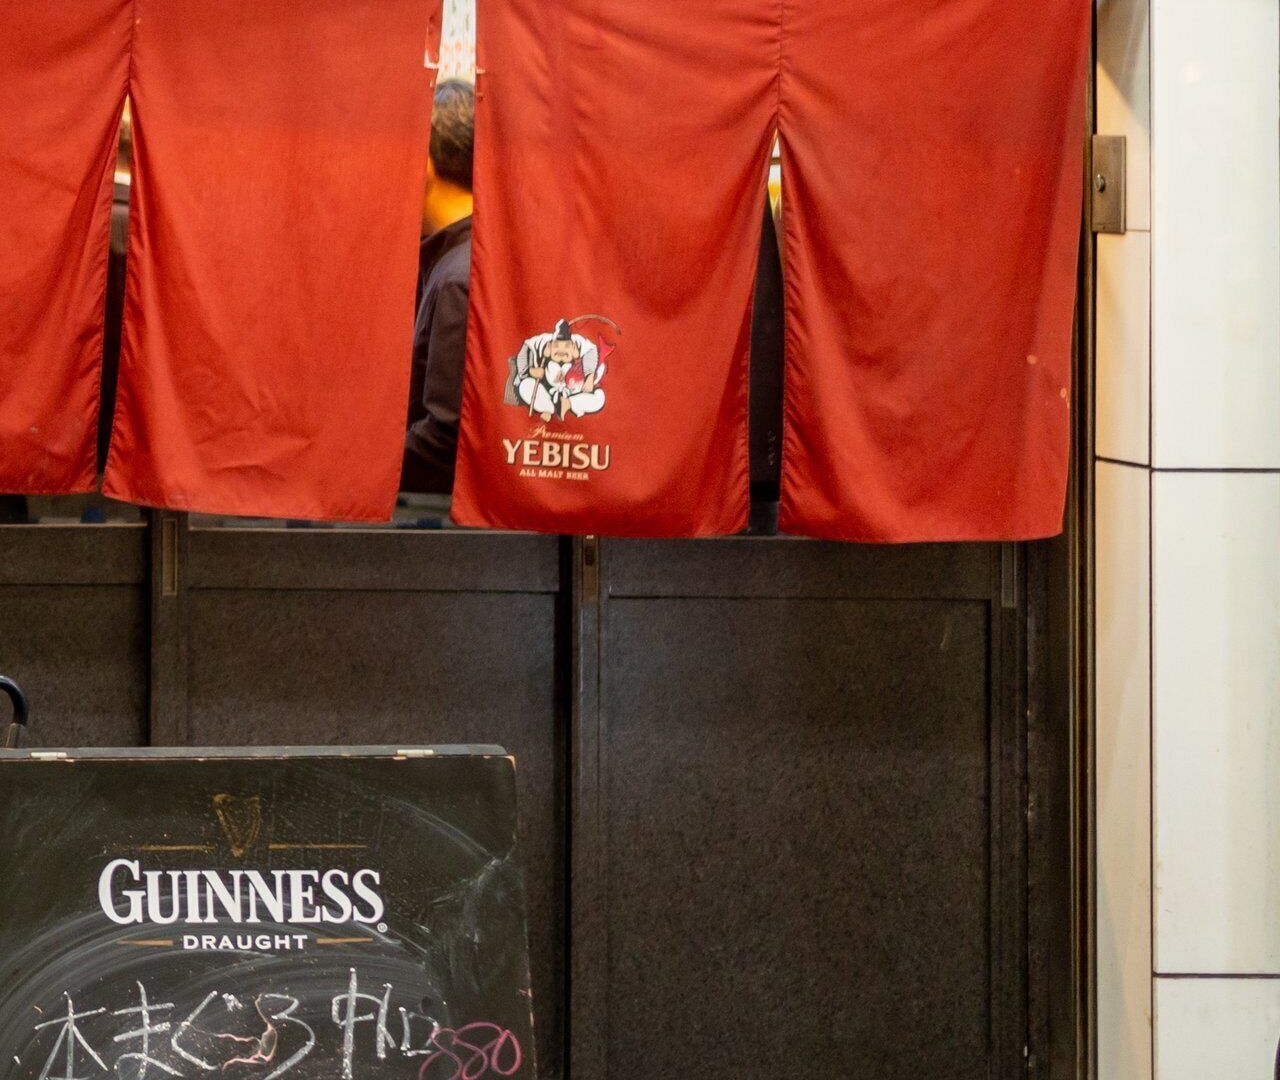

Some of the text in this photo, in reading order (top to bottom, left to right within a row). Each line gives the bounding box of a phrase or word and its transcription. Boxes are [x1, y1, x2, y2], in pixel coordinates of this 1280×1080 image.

[502, 438, 611, 471] YEBISU
[98, 858, 385, 924] GUINNESS
[182, 934, 308, 950] DRAUGHT
